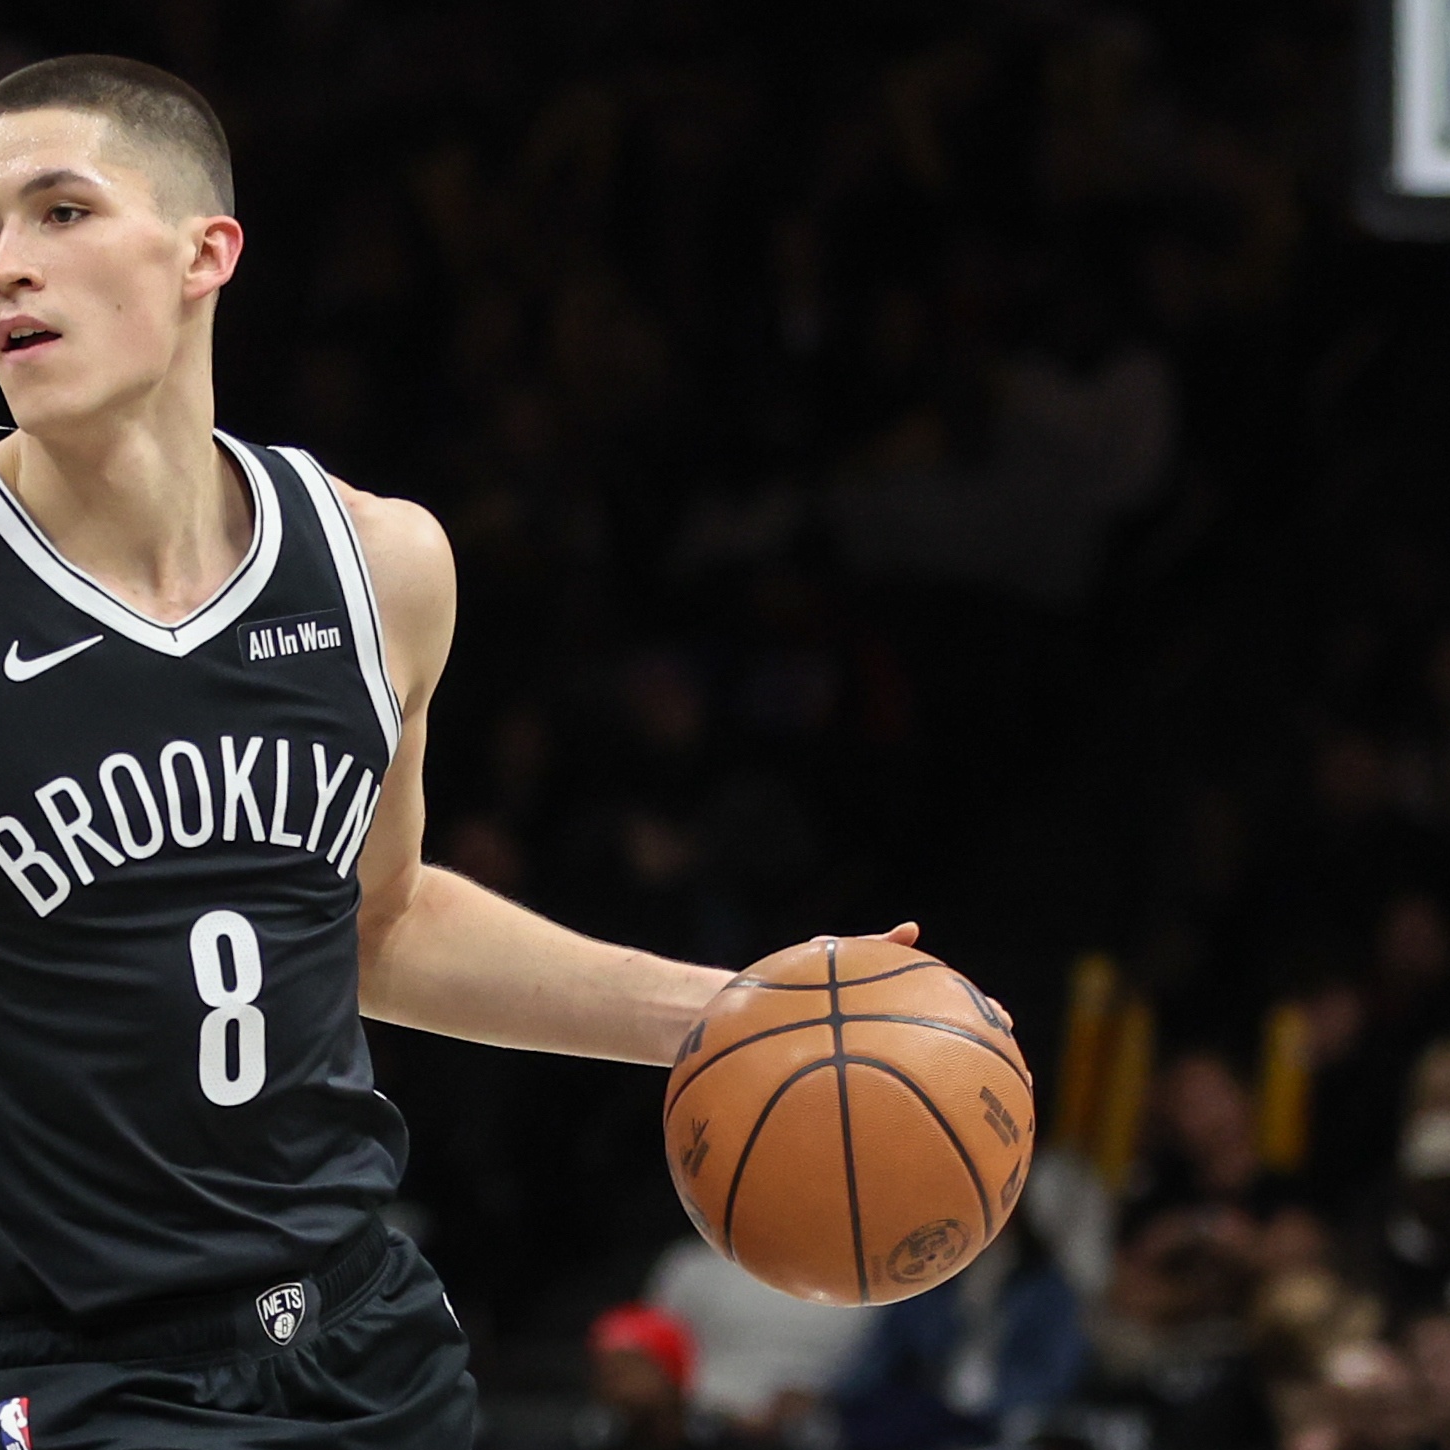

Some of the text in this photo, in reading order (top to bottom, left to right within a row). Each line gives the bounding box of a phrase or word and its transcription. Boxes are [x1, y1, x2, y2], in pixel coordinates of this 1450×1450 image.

[249, 621, 342, 661] All In Won
[188, 909, 267, 1107] 8
[261, 1287, 303, 1321] NETS
